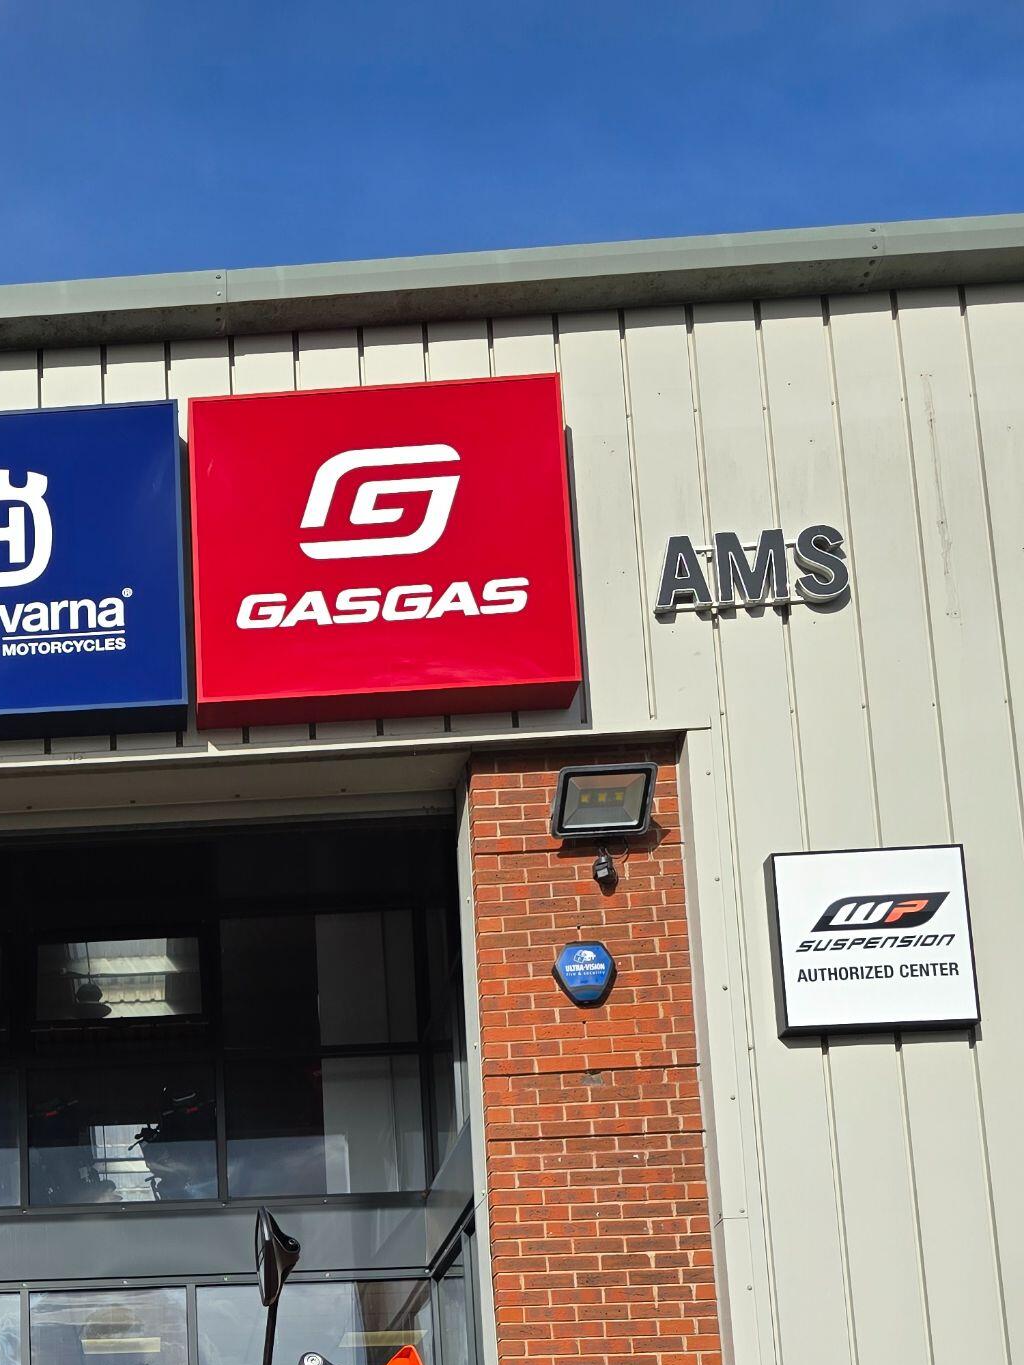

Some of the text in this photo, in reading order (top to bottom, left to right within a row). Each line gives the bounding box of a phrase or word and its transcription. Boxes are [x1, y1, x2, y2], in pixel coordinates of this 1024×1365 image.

[655, 524, 849, 610] AMS
[236, 576, 530, 631] GASGAS
[1, 636, 127, 657] MOTORCYCLES
[795, 933, 956, 953] SUSPENSION
[796, 961, 959, 983] AUTHORIZED CENTER
